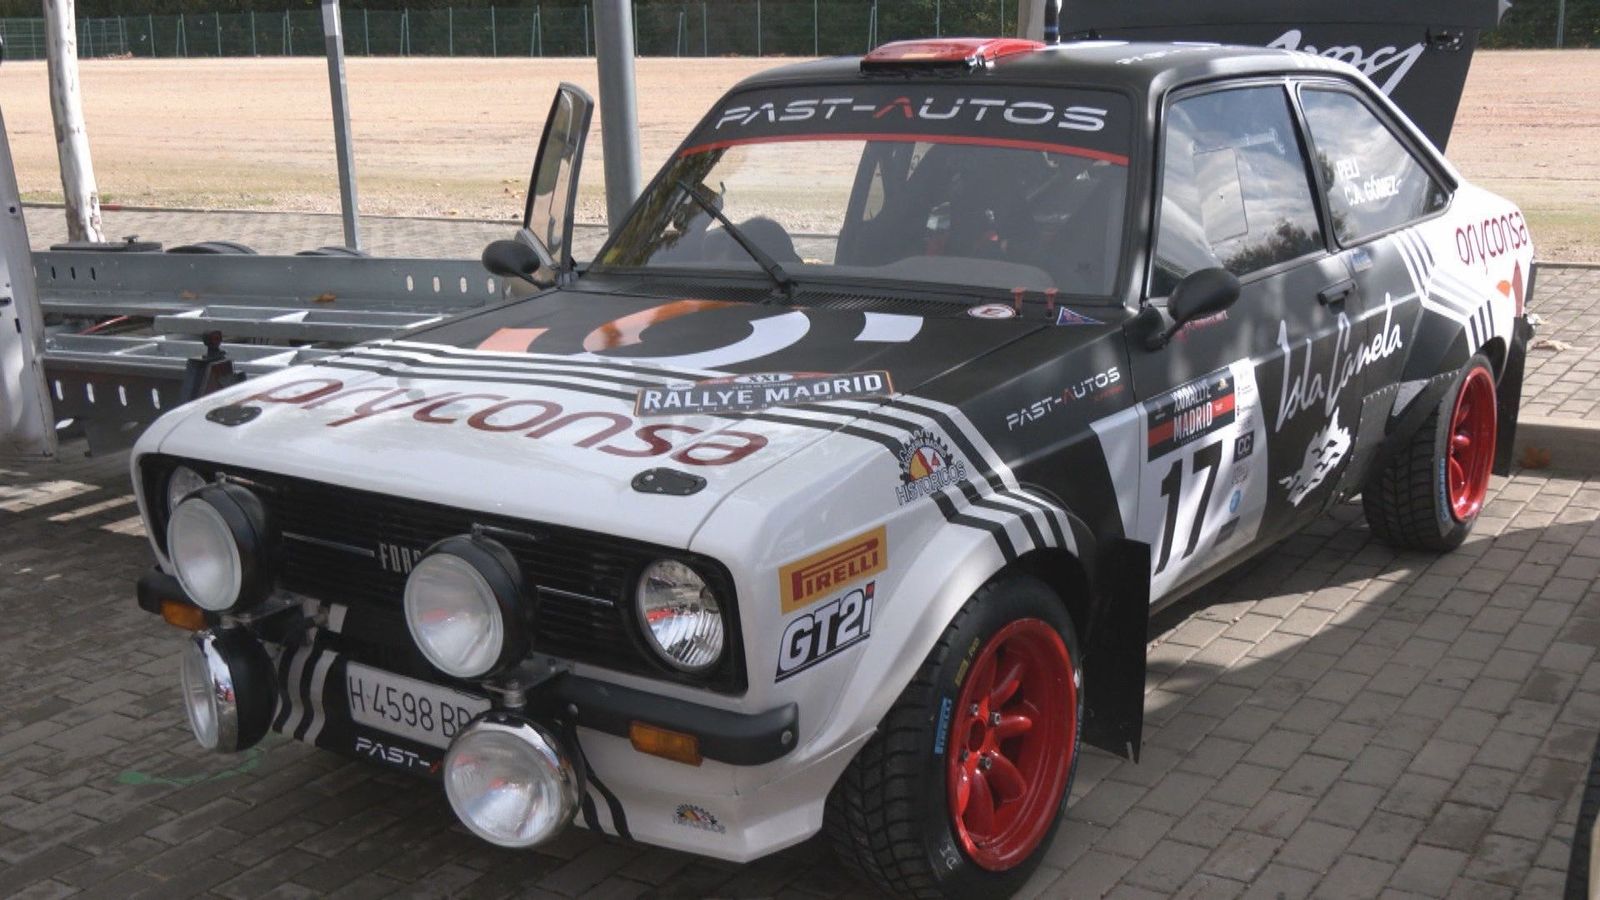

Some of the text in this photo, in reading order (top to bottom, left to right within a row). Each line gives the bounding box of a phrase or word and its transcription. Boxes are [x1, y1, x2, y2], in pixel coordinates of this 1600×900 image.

[714, 95, 1109, 132] FAST-AUTOS
[240, 378, 769, 466] pryconsa
[643, 388, 753, 410] RALLYE
[765, 373, 883, 403] MADRID
[1006, 366, 1121, 431] FAST-AUTOS
[1173, 401, 1214, 442] MADRID
[1153, 439, 1224, 576] 17
[791, 537, 879, 601] PIRELLI
[777, 580, 876, 680] GT2i
